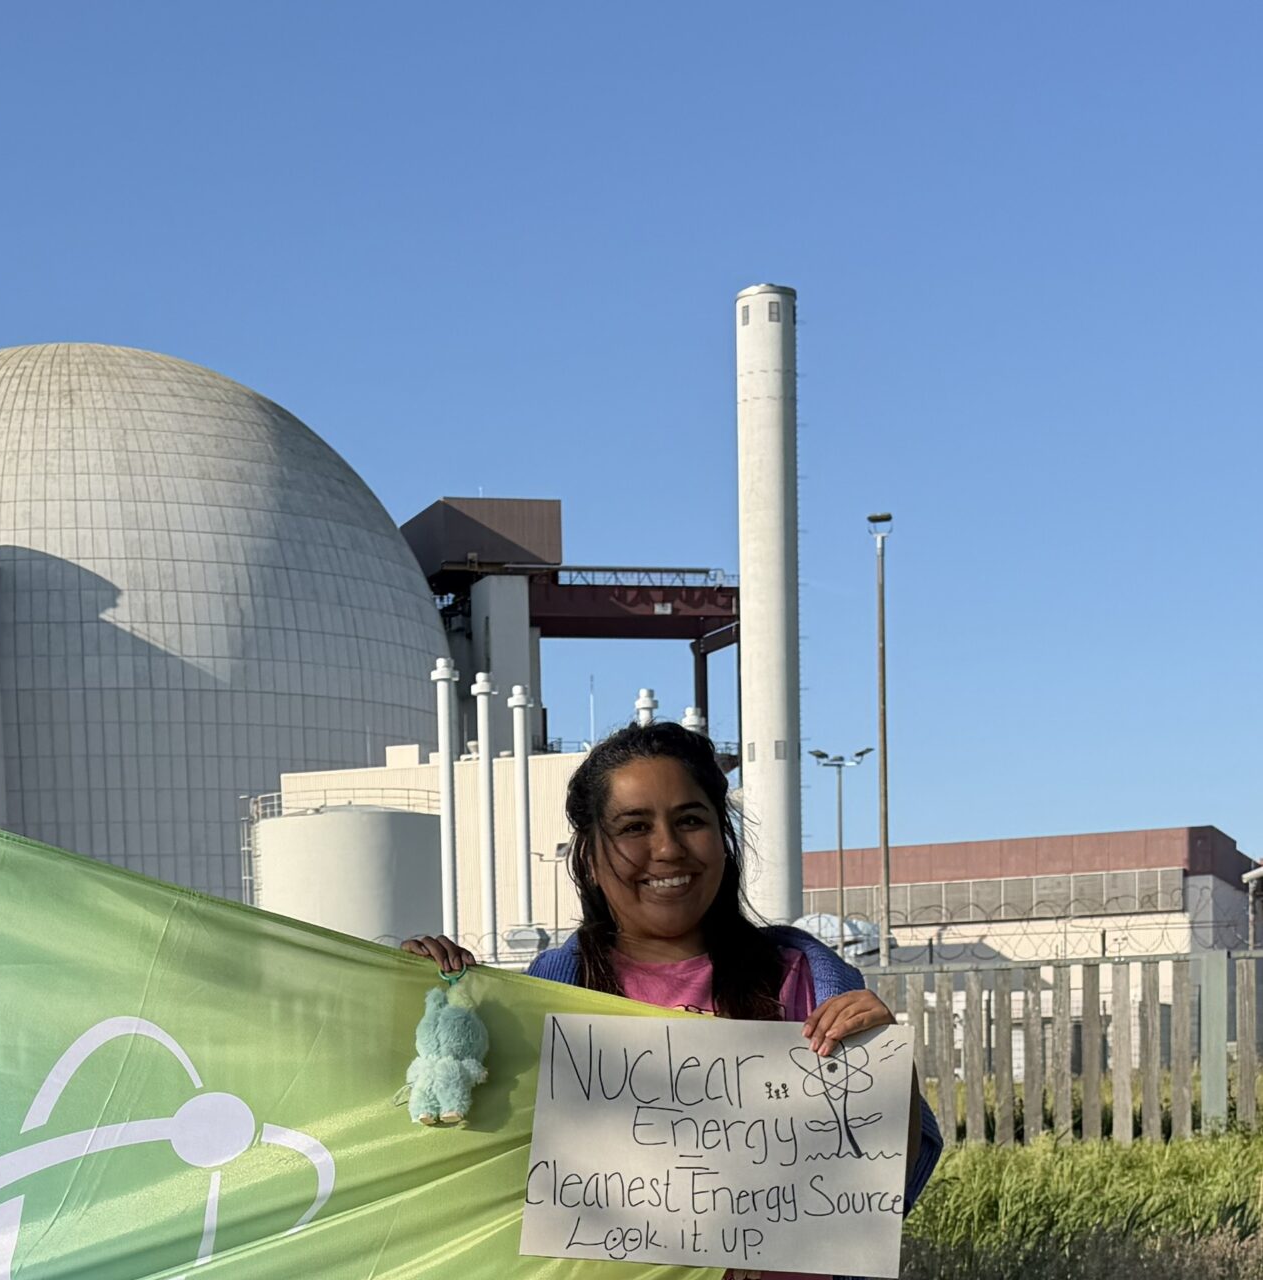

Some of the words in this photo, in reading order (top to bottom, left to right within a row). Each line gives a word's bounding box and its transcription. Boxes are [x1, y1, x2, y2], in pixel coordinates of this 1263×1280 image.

[550, 1015, 765, 1109] Nuclear
[632, 1105, 798, 1167] Energy
[525, 1159, 681, 1210] Cleanest
[690, 1171, 798, 1222] Energy
[803, 1174, 904, 1217] Source
